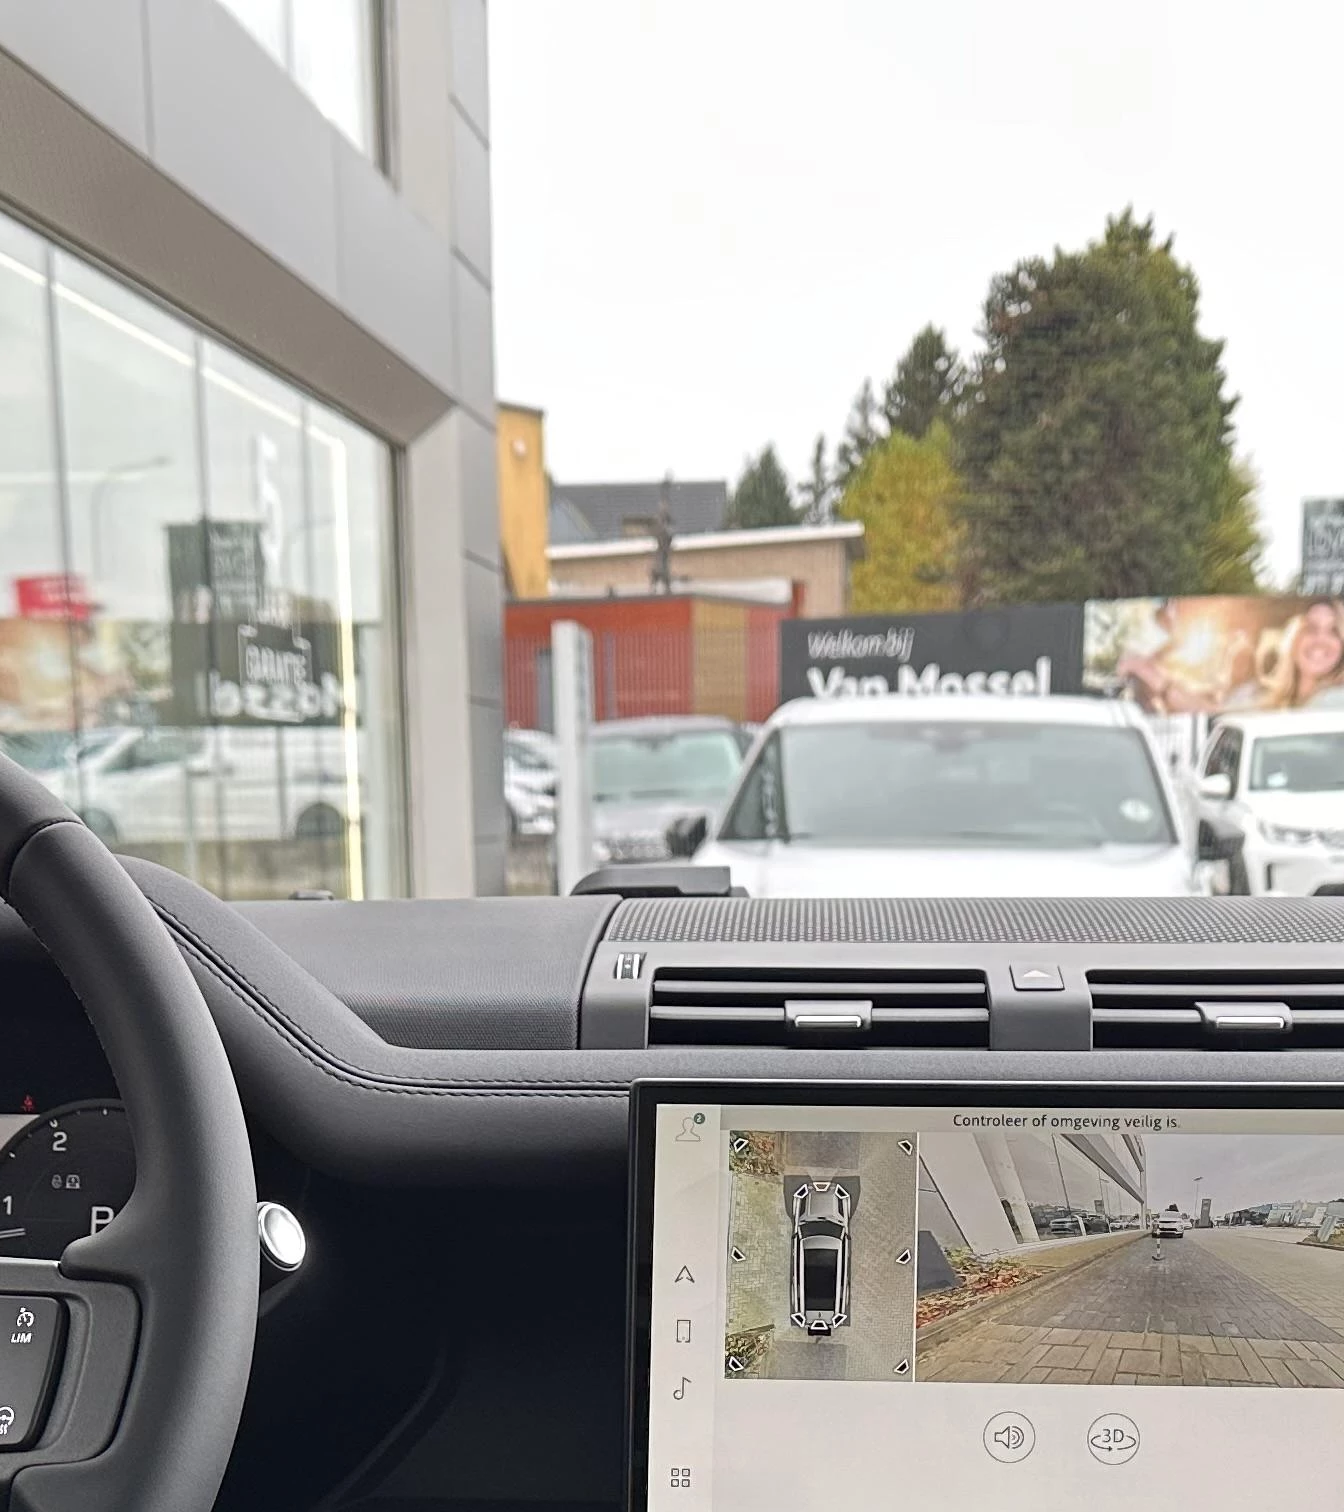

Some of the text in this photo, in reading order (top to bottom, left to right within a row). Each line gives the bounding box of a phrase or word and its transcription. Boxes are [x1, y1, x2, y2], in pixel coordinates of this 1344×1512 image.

[953, 1114, 1027, 1127] Controleer
[1032, 1114, 1048, 1127] of
[1050, 1116, 1120, 1131] omgeving
[1124, 1115, 1162, 1131] veilig
[52, 1131, 68, 1152] 2
[3, 1195, 13, 1216] 1
[90, 1206, 115, 1236] P
[10, 1332, 33, 1344] LIM
[1101, 1428, 1125, 1443] 3D
